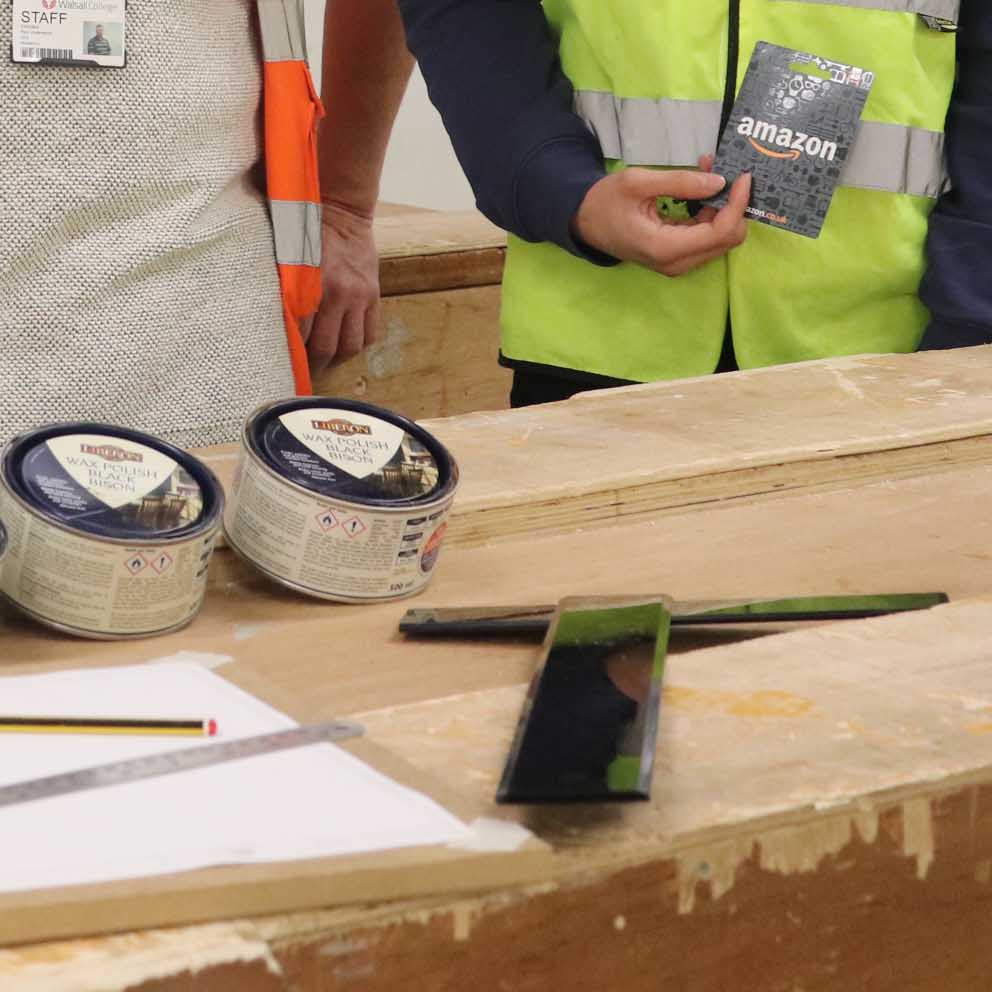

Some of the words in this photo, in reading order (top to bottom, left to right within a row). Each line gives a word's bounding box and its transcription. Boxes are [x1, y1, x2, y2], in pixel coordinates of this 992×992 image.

[21, 10, 68, 25] STAFF
[736, 115, 838, 161] amazon
[311, 420, 372, 436] LIBERON
[302, 432, 334, 443] WAX
[337, 436, 390, 450] POLISH
[326, 444, 369, 456] BLACK
[327, 451, 374, 465] BISON
[66, 456, 98, 470] WAX
[103, 462, 158, 480] POLISH
